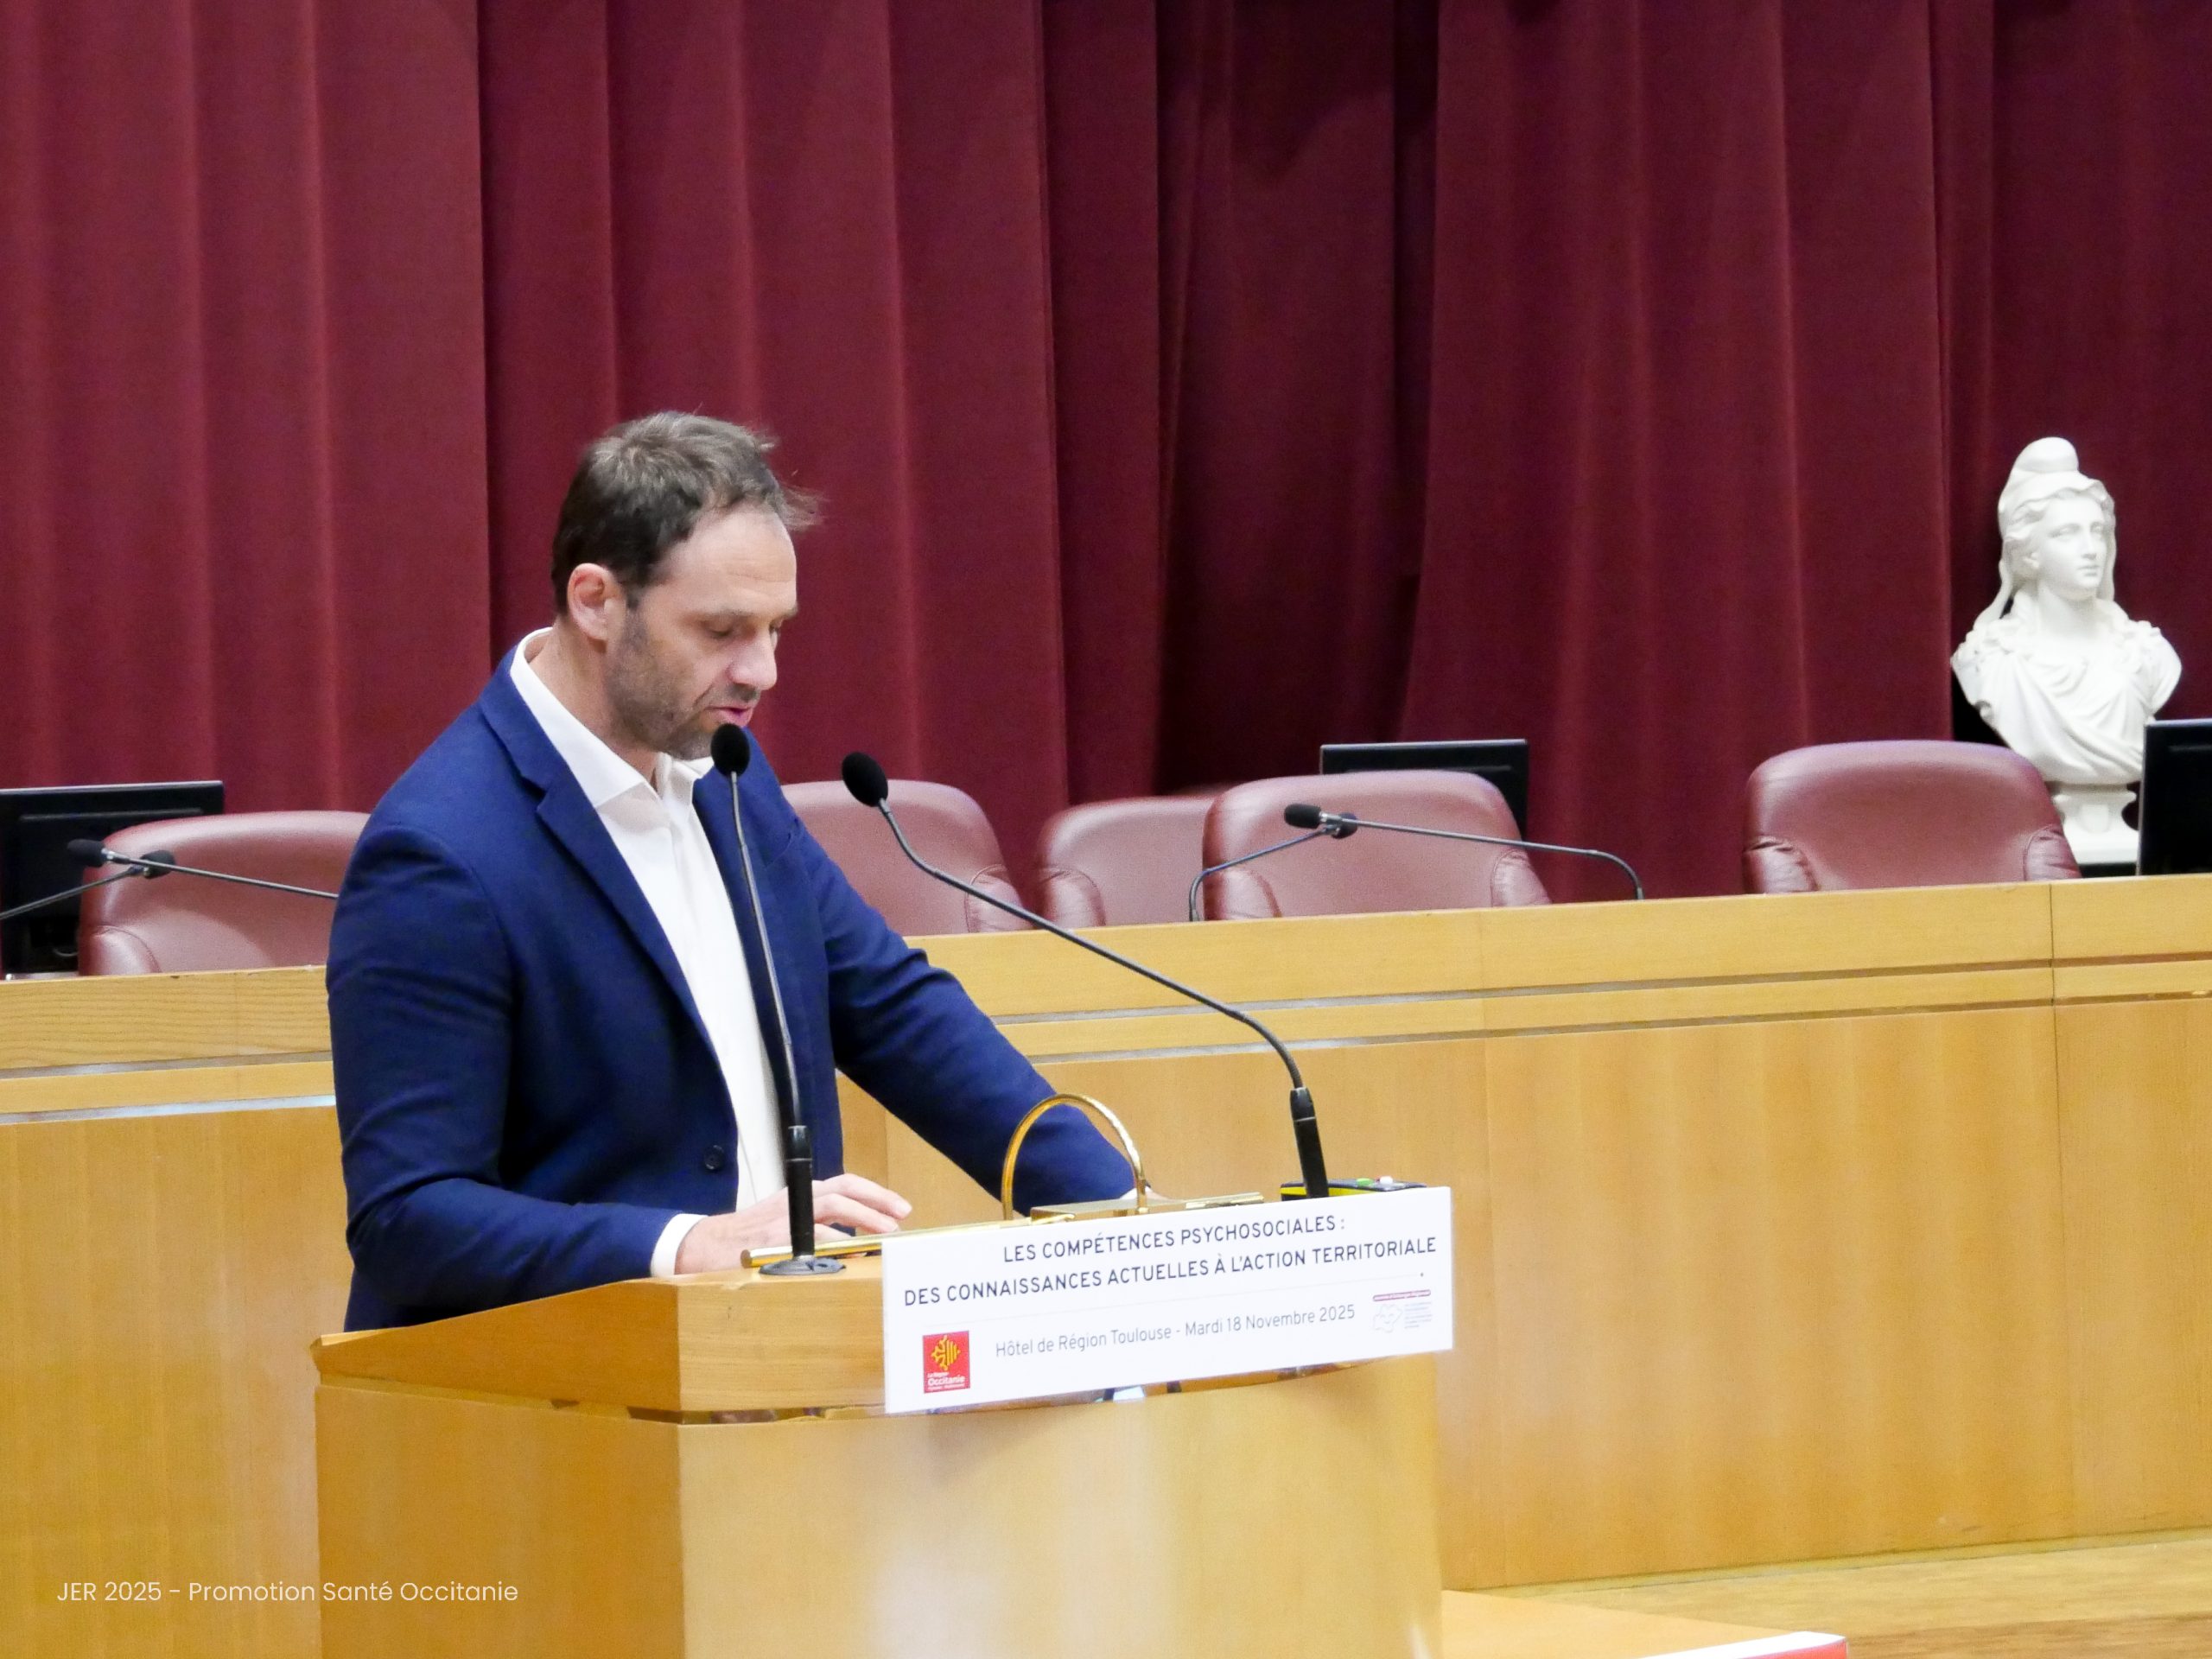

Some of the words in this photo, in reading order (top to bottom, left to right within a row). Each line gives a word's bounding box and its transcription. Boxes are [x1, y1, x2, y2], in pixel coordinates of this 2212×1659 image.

[1003, 1243, 1036, 1263] LES
[1041, 1230, 1175, 1259] COMPÉTENCES
[1179, 1214, 1337, 1246] PSYCHOSOCIALES
[904, 1287, 941, 1306] DES
[946, 1270, 1103, 1302] CONNAISSANCES
[1107, 1259, 1210, 1286] ACTUELLES
[1213, 1254, 1227, 1274] À
[1231, 1249, 1306, 1273] L'ACTION
[1312, 1236, 1436, 1264] TERRITORIALE
[995, 1338, 1033, 1357] Hôtel
[1037, 1338, 1054, 1353] de
[1058, 1333, 1107, 1353] Région
[1110, 1326, 1172, 1345] Toulouse
[1185, 1320, 1224, 1338] Mardi
[1227, 1316, 1243, 1332] 18
[1246, 1310, 1315, 1331] Novembre
[1319, 1304, 1356, 1323] 2025
